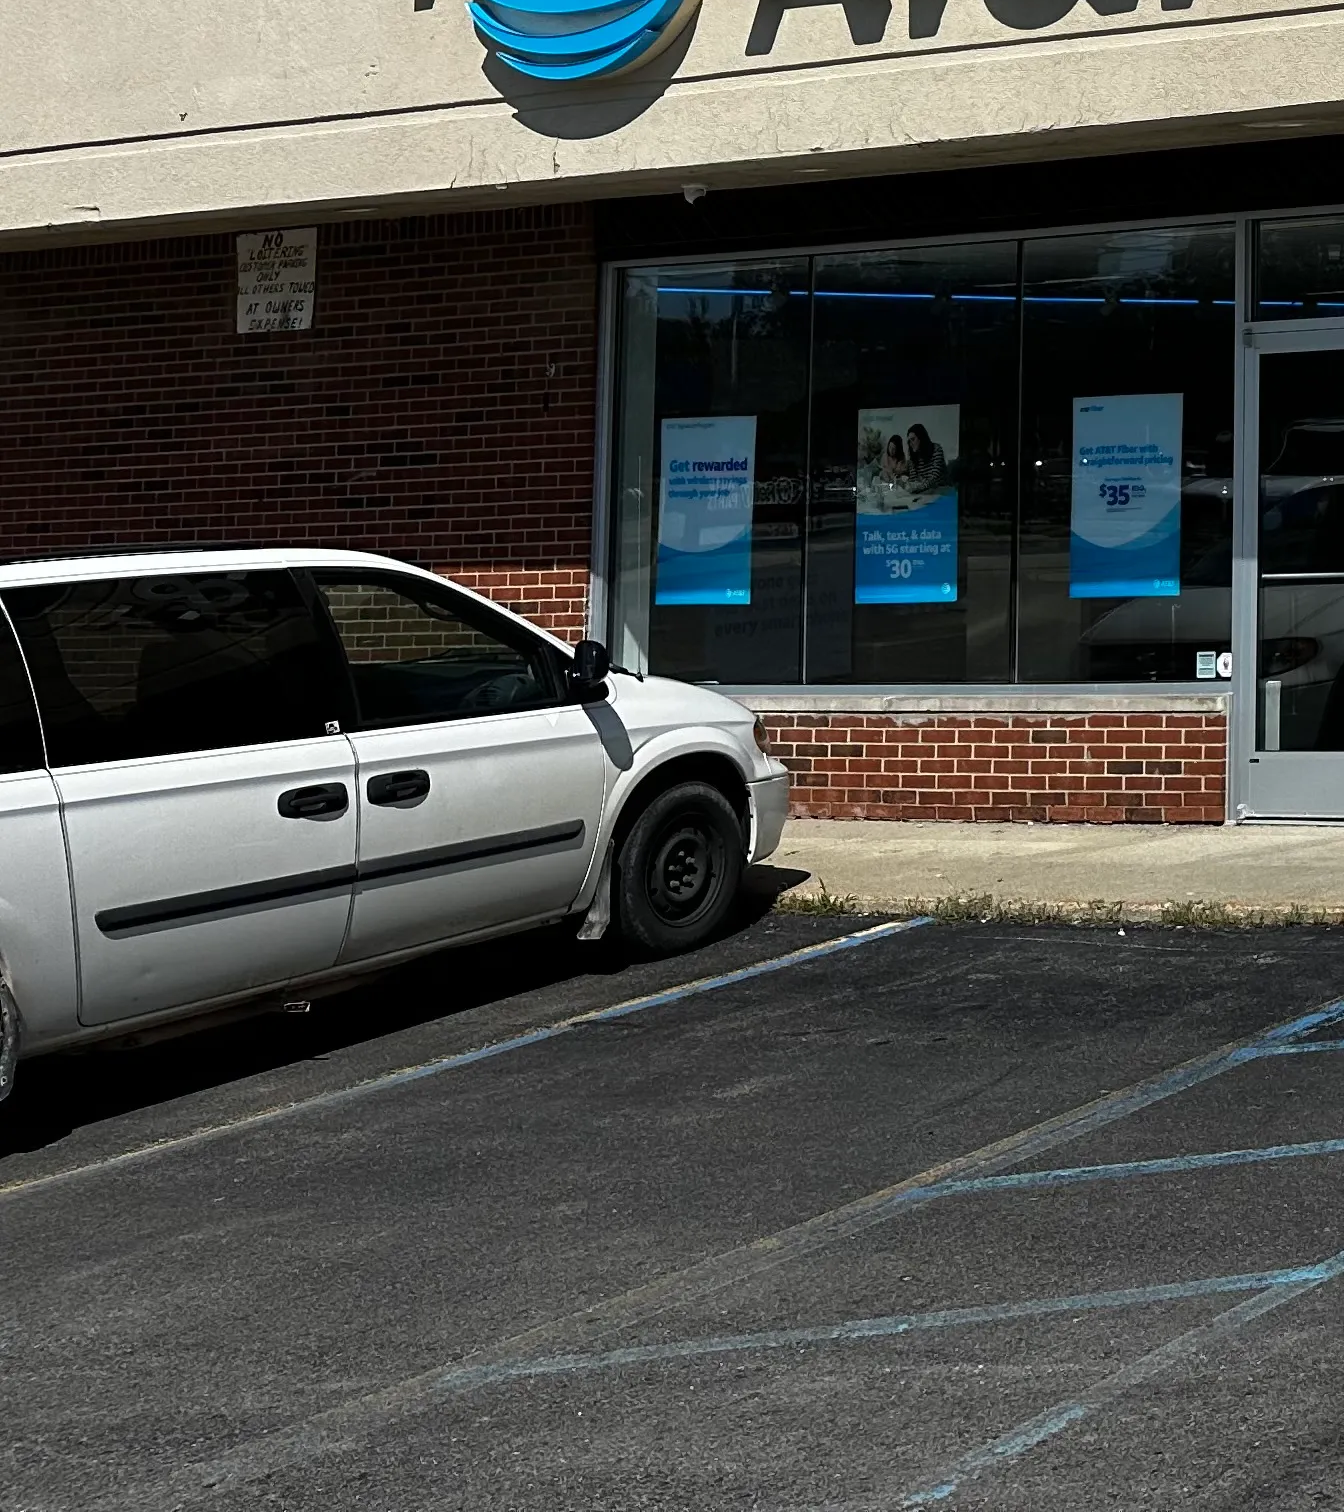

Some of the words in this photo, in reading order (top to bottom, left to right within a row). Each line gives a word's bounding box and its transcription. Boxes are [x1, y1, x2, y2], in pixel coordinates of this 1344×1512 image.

[262, 231, 284, 249] NO
[256, 271, 281, 283] ONLY
[252, 283, 285, 295] OTHERS
[289, 281, 315, 294] TOWED
[246, 302, 260, 316] AT
[265, 300, 306, 314] OWNERS
[248, 317, 303, 331] EXPENSE!
[669, 459, 691, 473] Get
[692, 457, 748, 472] rewarded
[1098, 483, 1130, 507] $35
[862, 530, 885, 543] Talk,
[911, 529, 919, 540] &
[919, 529, 942, 540] data
[863, 544, 884, 555] with
[900, 543, 939, 555] starting
[940, 543, 951, 553] at
[885, 559, 912, 578] $30
